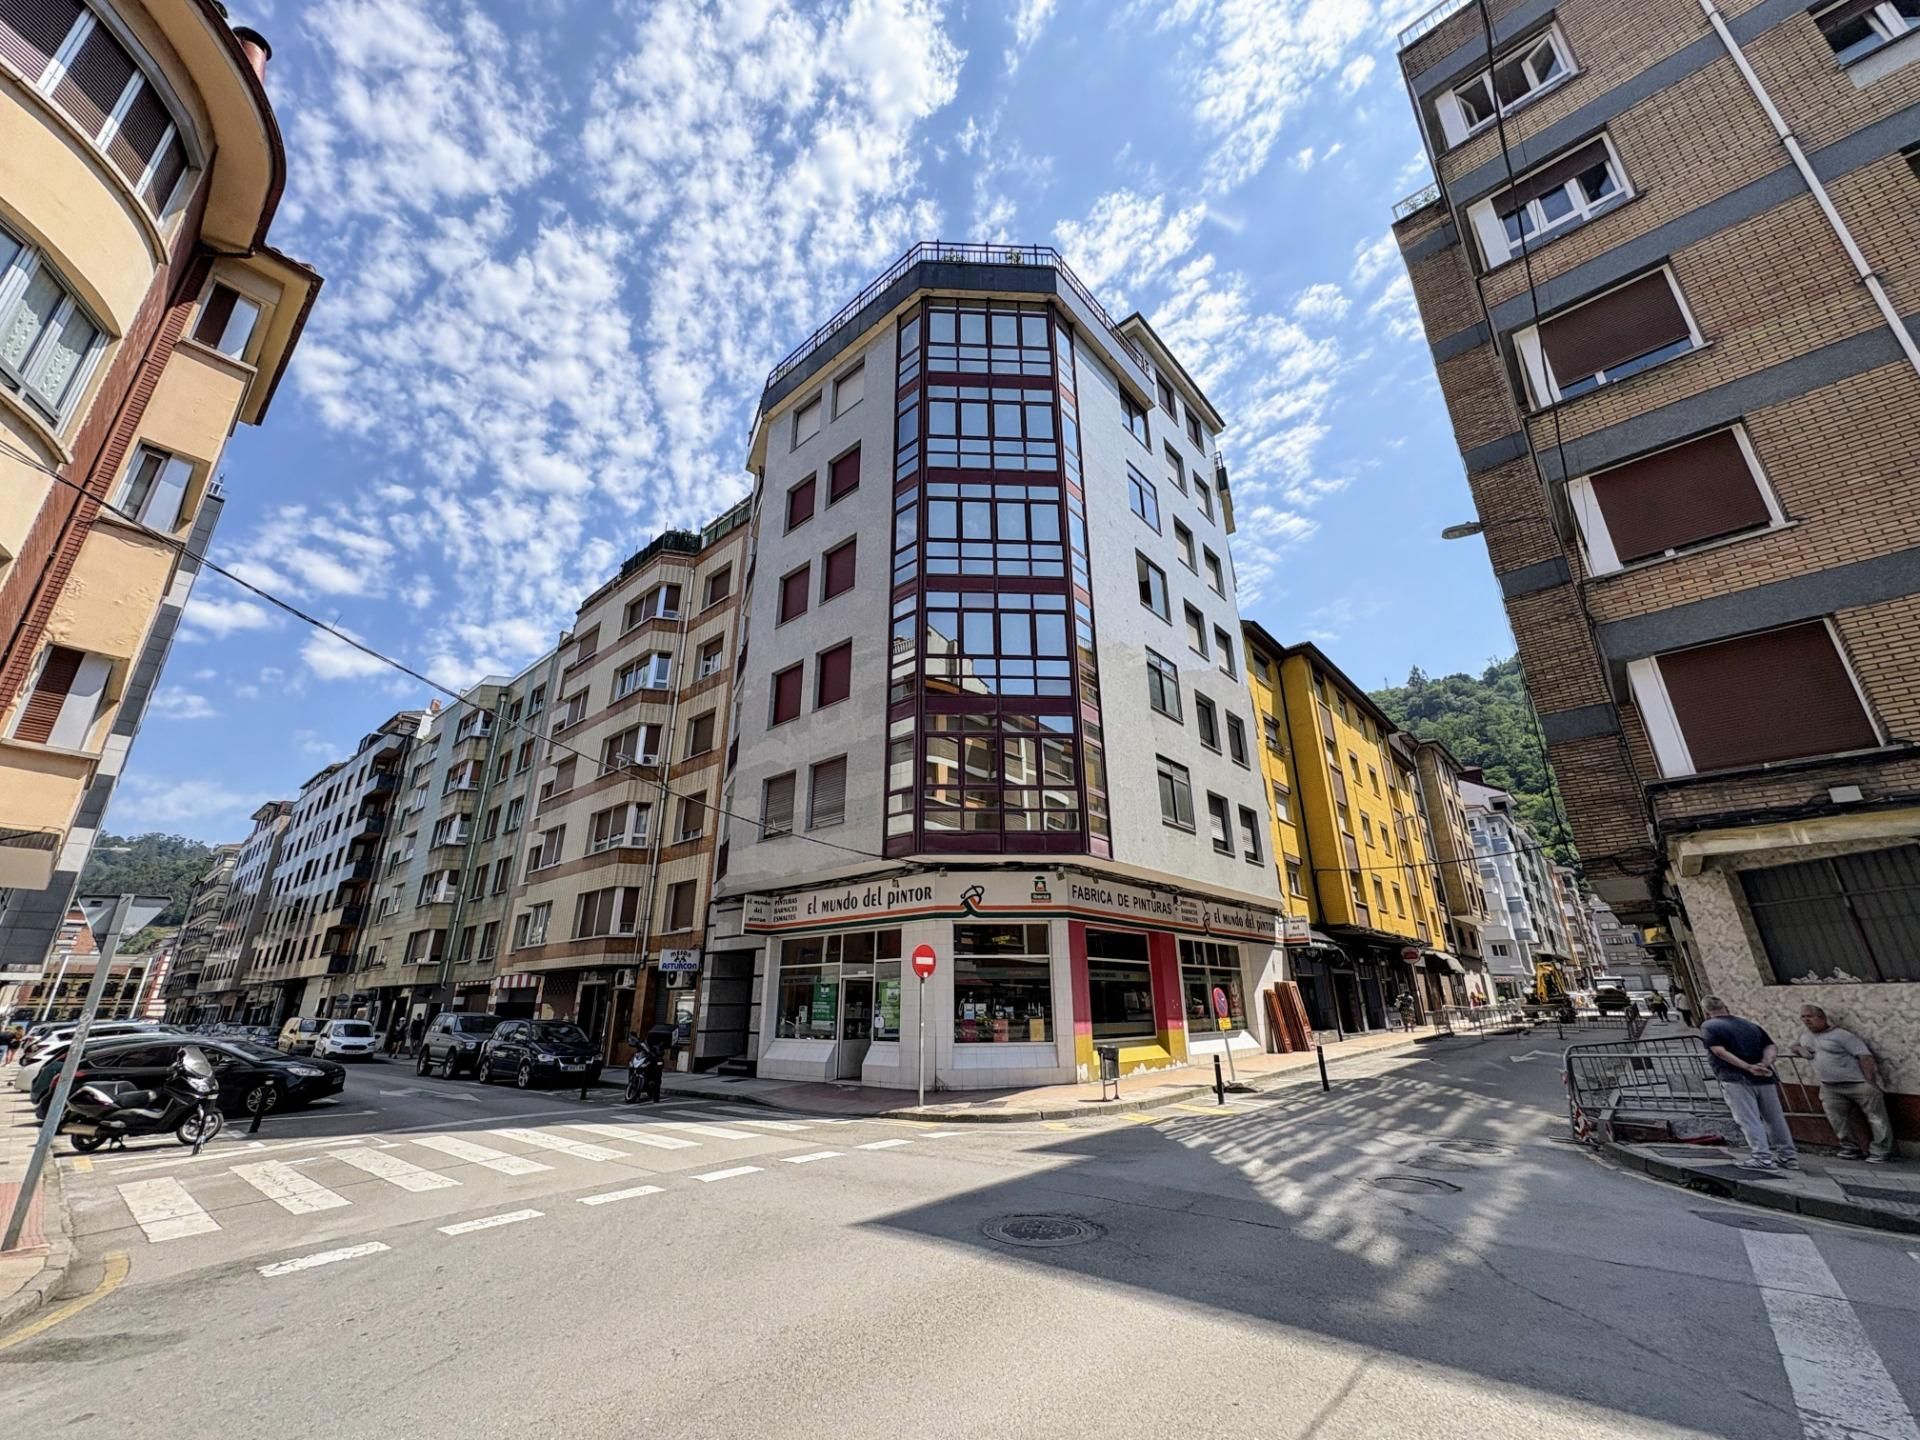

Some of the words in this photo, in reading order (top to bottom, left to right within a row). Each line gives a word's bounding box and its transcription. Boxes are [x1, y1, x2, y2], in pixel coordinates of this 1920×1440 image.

[807, 895, 818, 915] El
[1071, 884, 1114, 906] FABRICA
[1117, 893, 1130, 909] DE
[1133, 896, 1173, 916] PINTURAS
